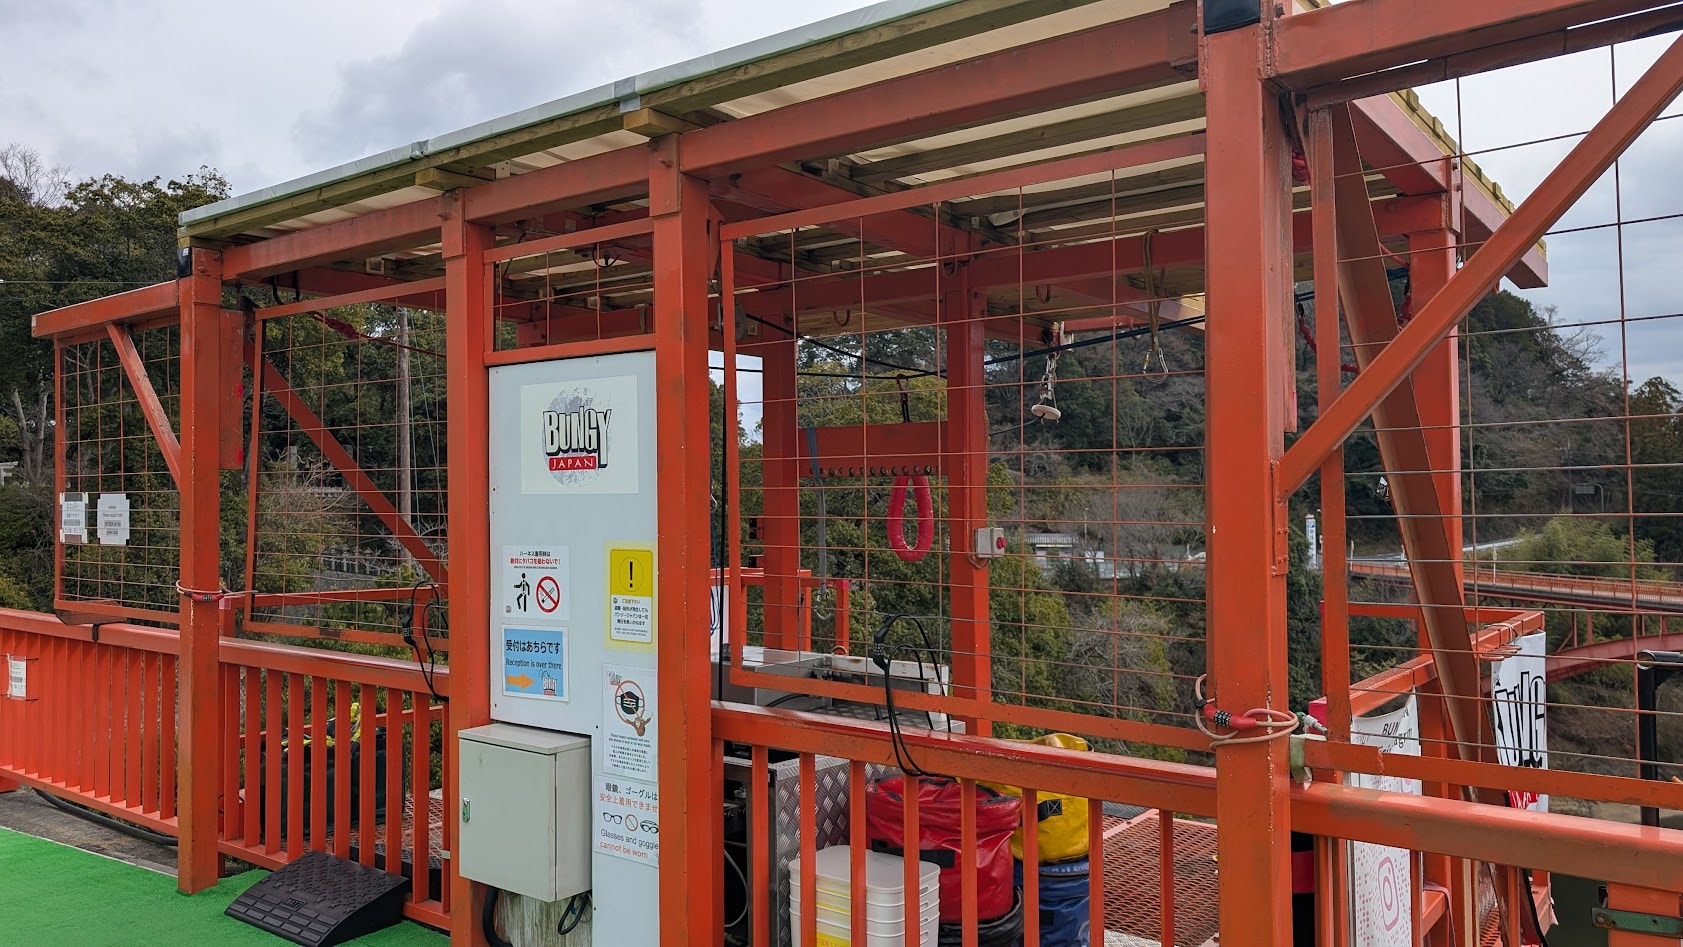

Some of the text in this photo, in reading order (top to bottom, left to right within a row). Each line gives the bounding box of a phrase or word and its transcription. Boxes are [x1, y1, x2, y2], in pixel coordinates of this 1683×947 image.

[542, 406, 612, 468] BUNGY
[552, 458, 595, 470] JAPAN
[505, 639, 561, 654] 受付はあちらです
[505, 658, 562, 670] Reception is over there
[600, 793, 658, 813] 安全上着用できませ
[600, 829, 659, 850] Glasses and goggle
[599, 841, 648, 859] cannot be worn
